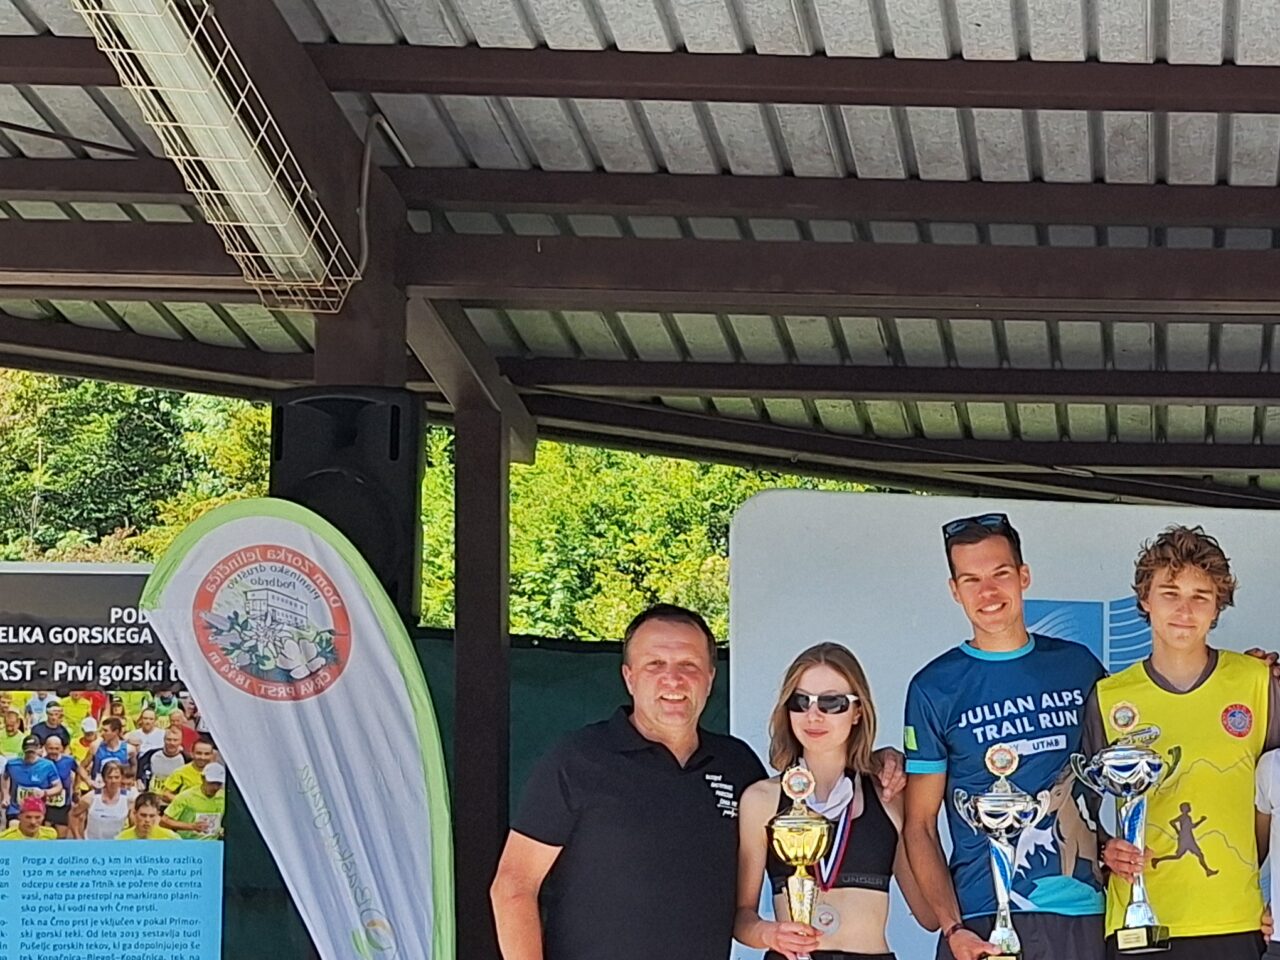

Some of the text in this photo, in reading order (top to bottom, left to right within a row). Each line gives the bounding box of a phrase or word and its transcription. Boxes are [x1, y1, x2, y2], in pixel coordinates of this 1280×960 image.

[49, 627, 153, 644] GORSKEGA
[54, 661, 93, 681] Prvi
[99, 661, 163, 686] gorski
[169, 661, 185, 682] t
[958, 689, 1084, 728] JULIAN ALPS
[972, 709, 1079, 744] TRAIL RUN
[1032, 739, 1061, 751] UTMB
